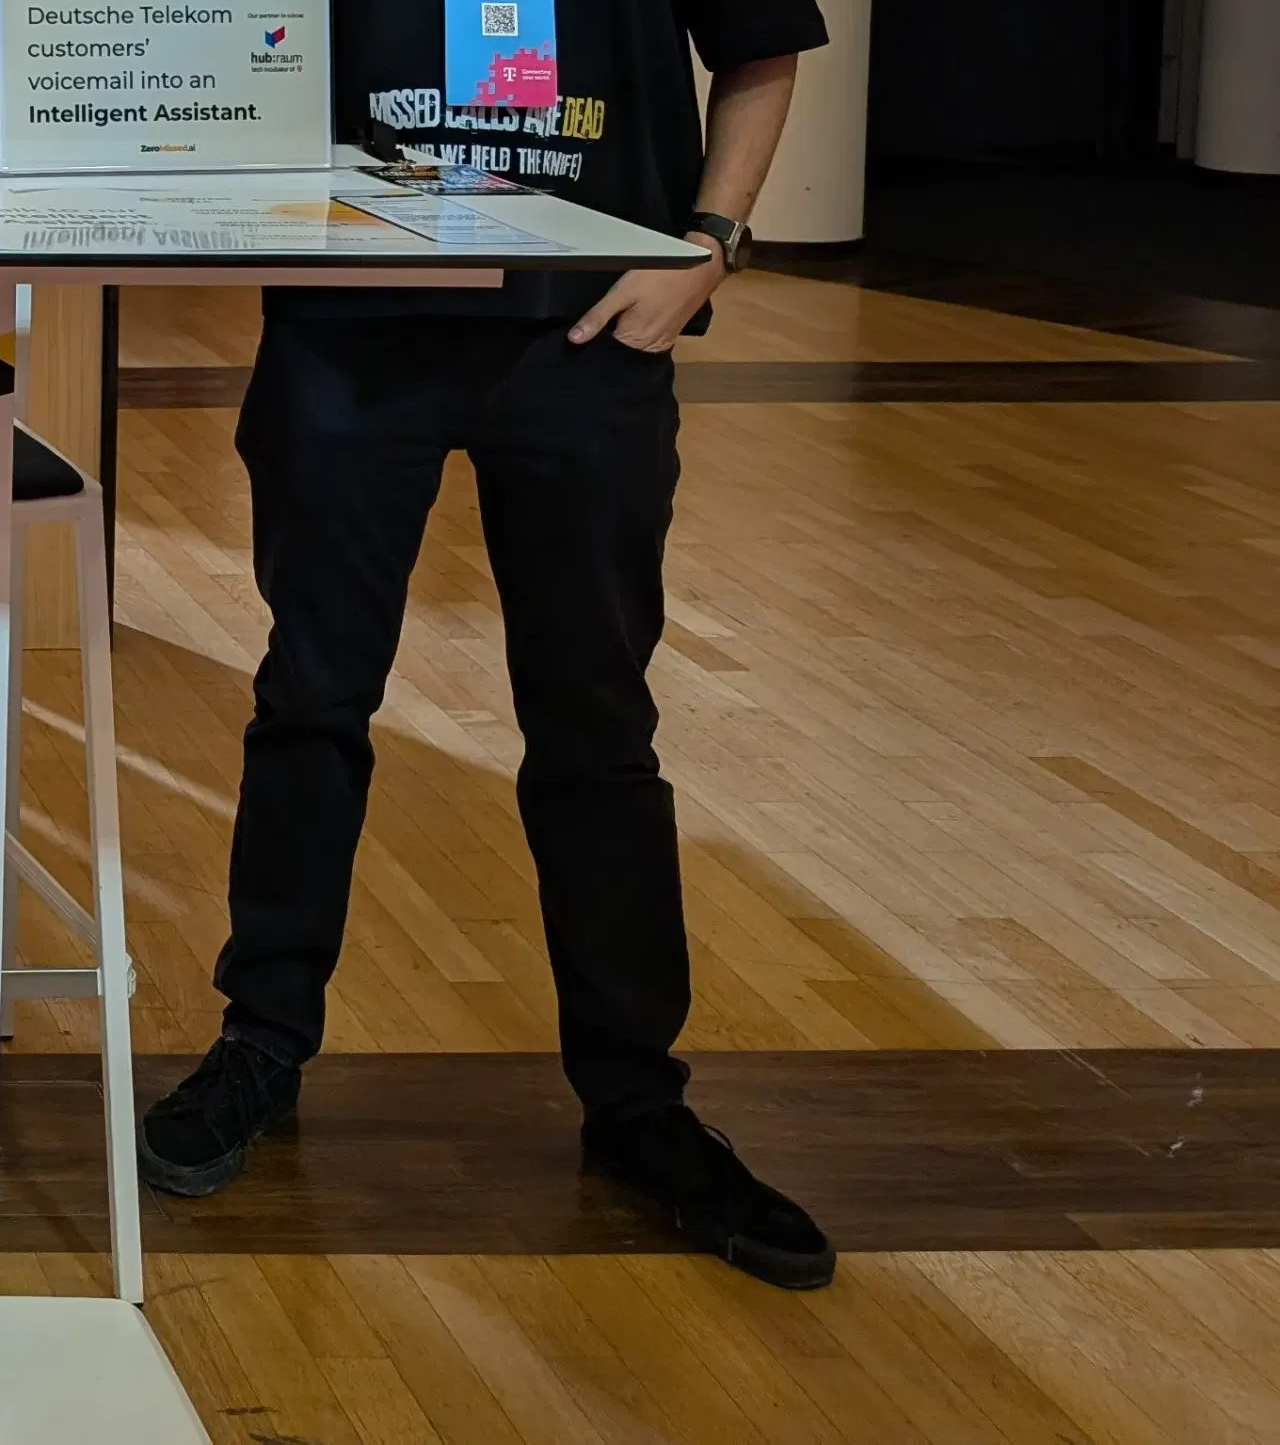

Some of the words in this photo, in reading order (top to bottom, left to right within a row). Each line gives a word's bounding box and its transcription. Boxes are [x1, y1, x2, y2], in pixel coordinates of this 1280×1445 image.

[28, 6, 134, 24] Deutsche
[140, 5, 232, 24] Telekom
[251, 52, 303, 63] hub:raum
[28, 70, 134, 90] voicemail
[141, 71, 183, 89] into
[190, 74, 216, 89] an
[30, 103, 148, 127] Intelligent
[153, 102, 262, 122] Assistant.
[562, 96, 606, 139] DEAD
[471, 145, 511, 172] HELD
[517, 148, 541, 174] THE
[542, 150, 583, 181] KNIFE)
